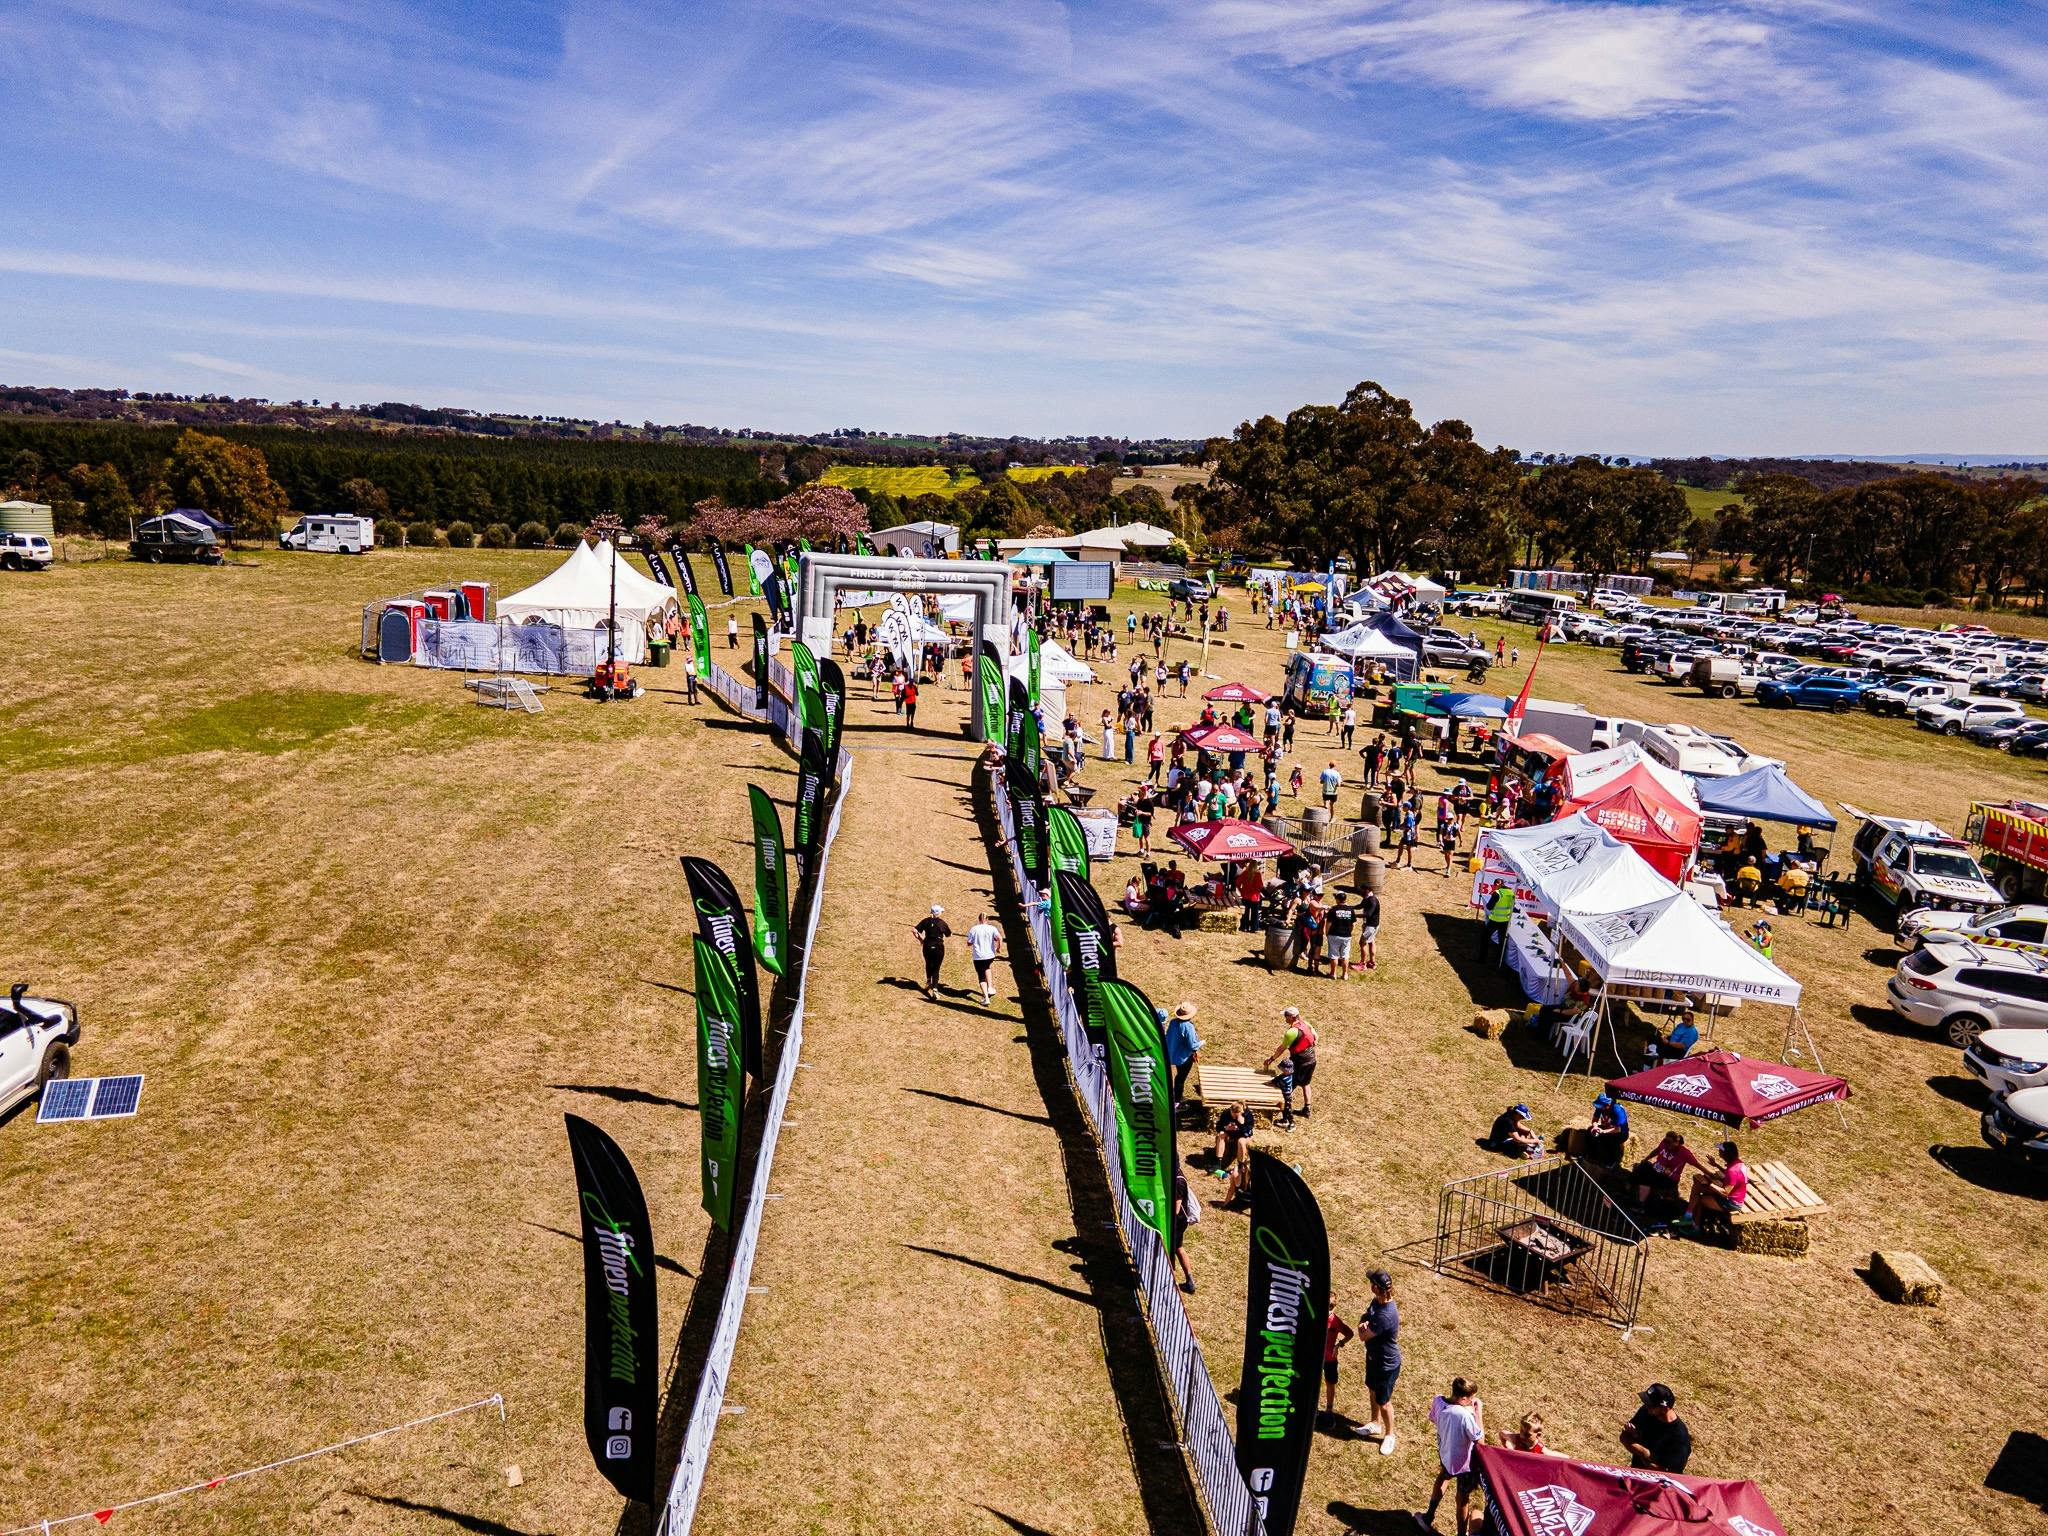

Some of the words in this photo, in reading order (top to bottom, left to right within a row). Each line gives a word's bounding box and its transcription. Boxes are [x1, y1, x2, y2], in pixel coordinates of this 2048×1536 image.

[850, 568, 885, 579] FINISH
[938, 573, 970, 582] START
[1596, 817, 1641, 831] BREWING
[1598, 809, 1647, 827] RECKLESS
[1625, 968, 1675, 984] LONELY
[1678, 975, 1739, 992] MOUNTAIN
[1744, 984, 1781, 998] ULTRA
[1644, 1095, 1692, 1114] MOUNTAIN
[1694, 1107, 1726, 1121] ULTRA
